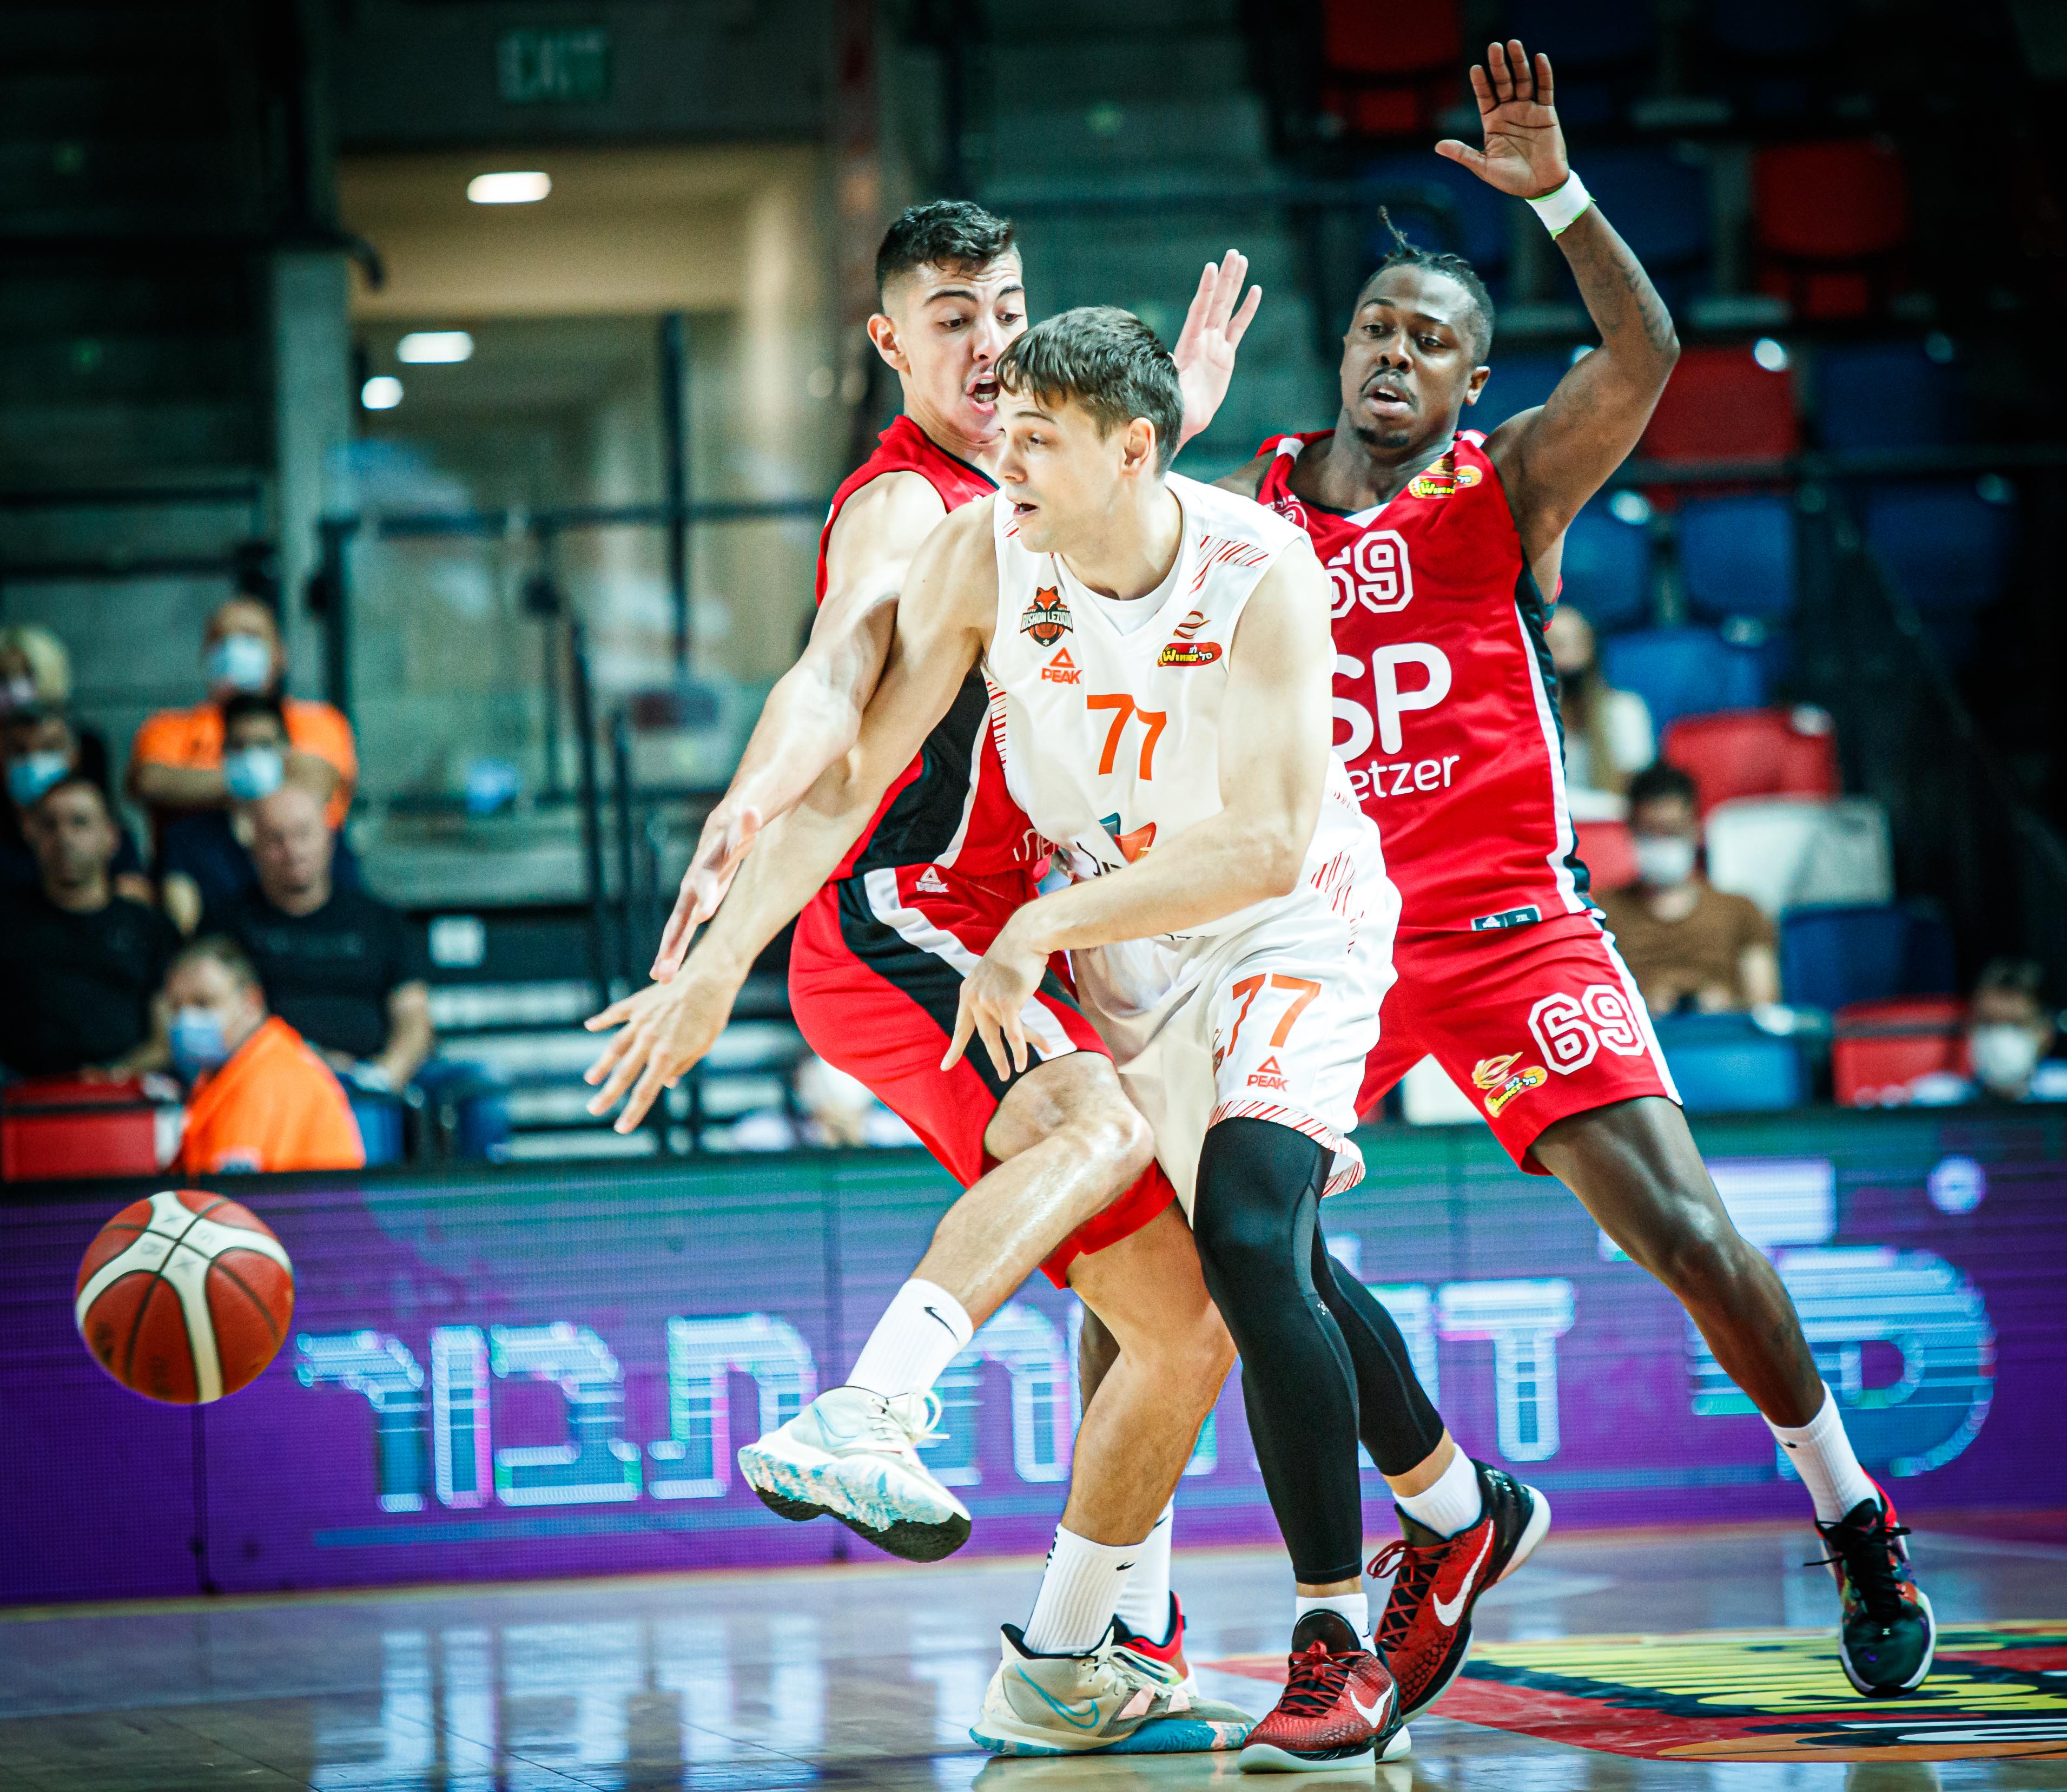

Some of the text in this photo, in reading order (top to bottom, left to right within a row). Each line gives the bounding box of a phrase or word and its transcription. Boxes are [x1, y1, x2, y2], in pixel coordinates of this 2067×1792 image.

[1041, 668, 1082, 684] PEAK
[1087, 694, 1167, 781] 77
[1227, 973, 1321, 1057] 77
[1528, 984, 1647, 1076] 69
[1246, 1074, 1290, 1092] PEAK
